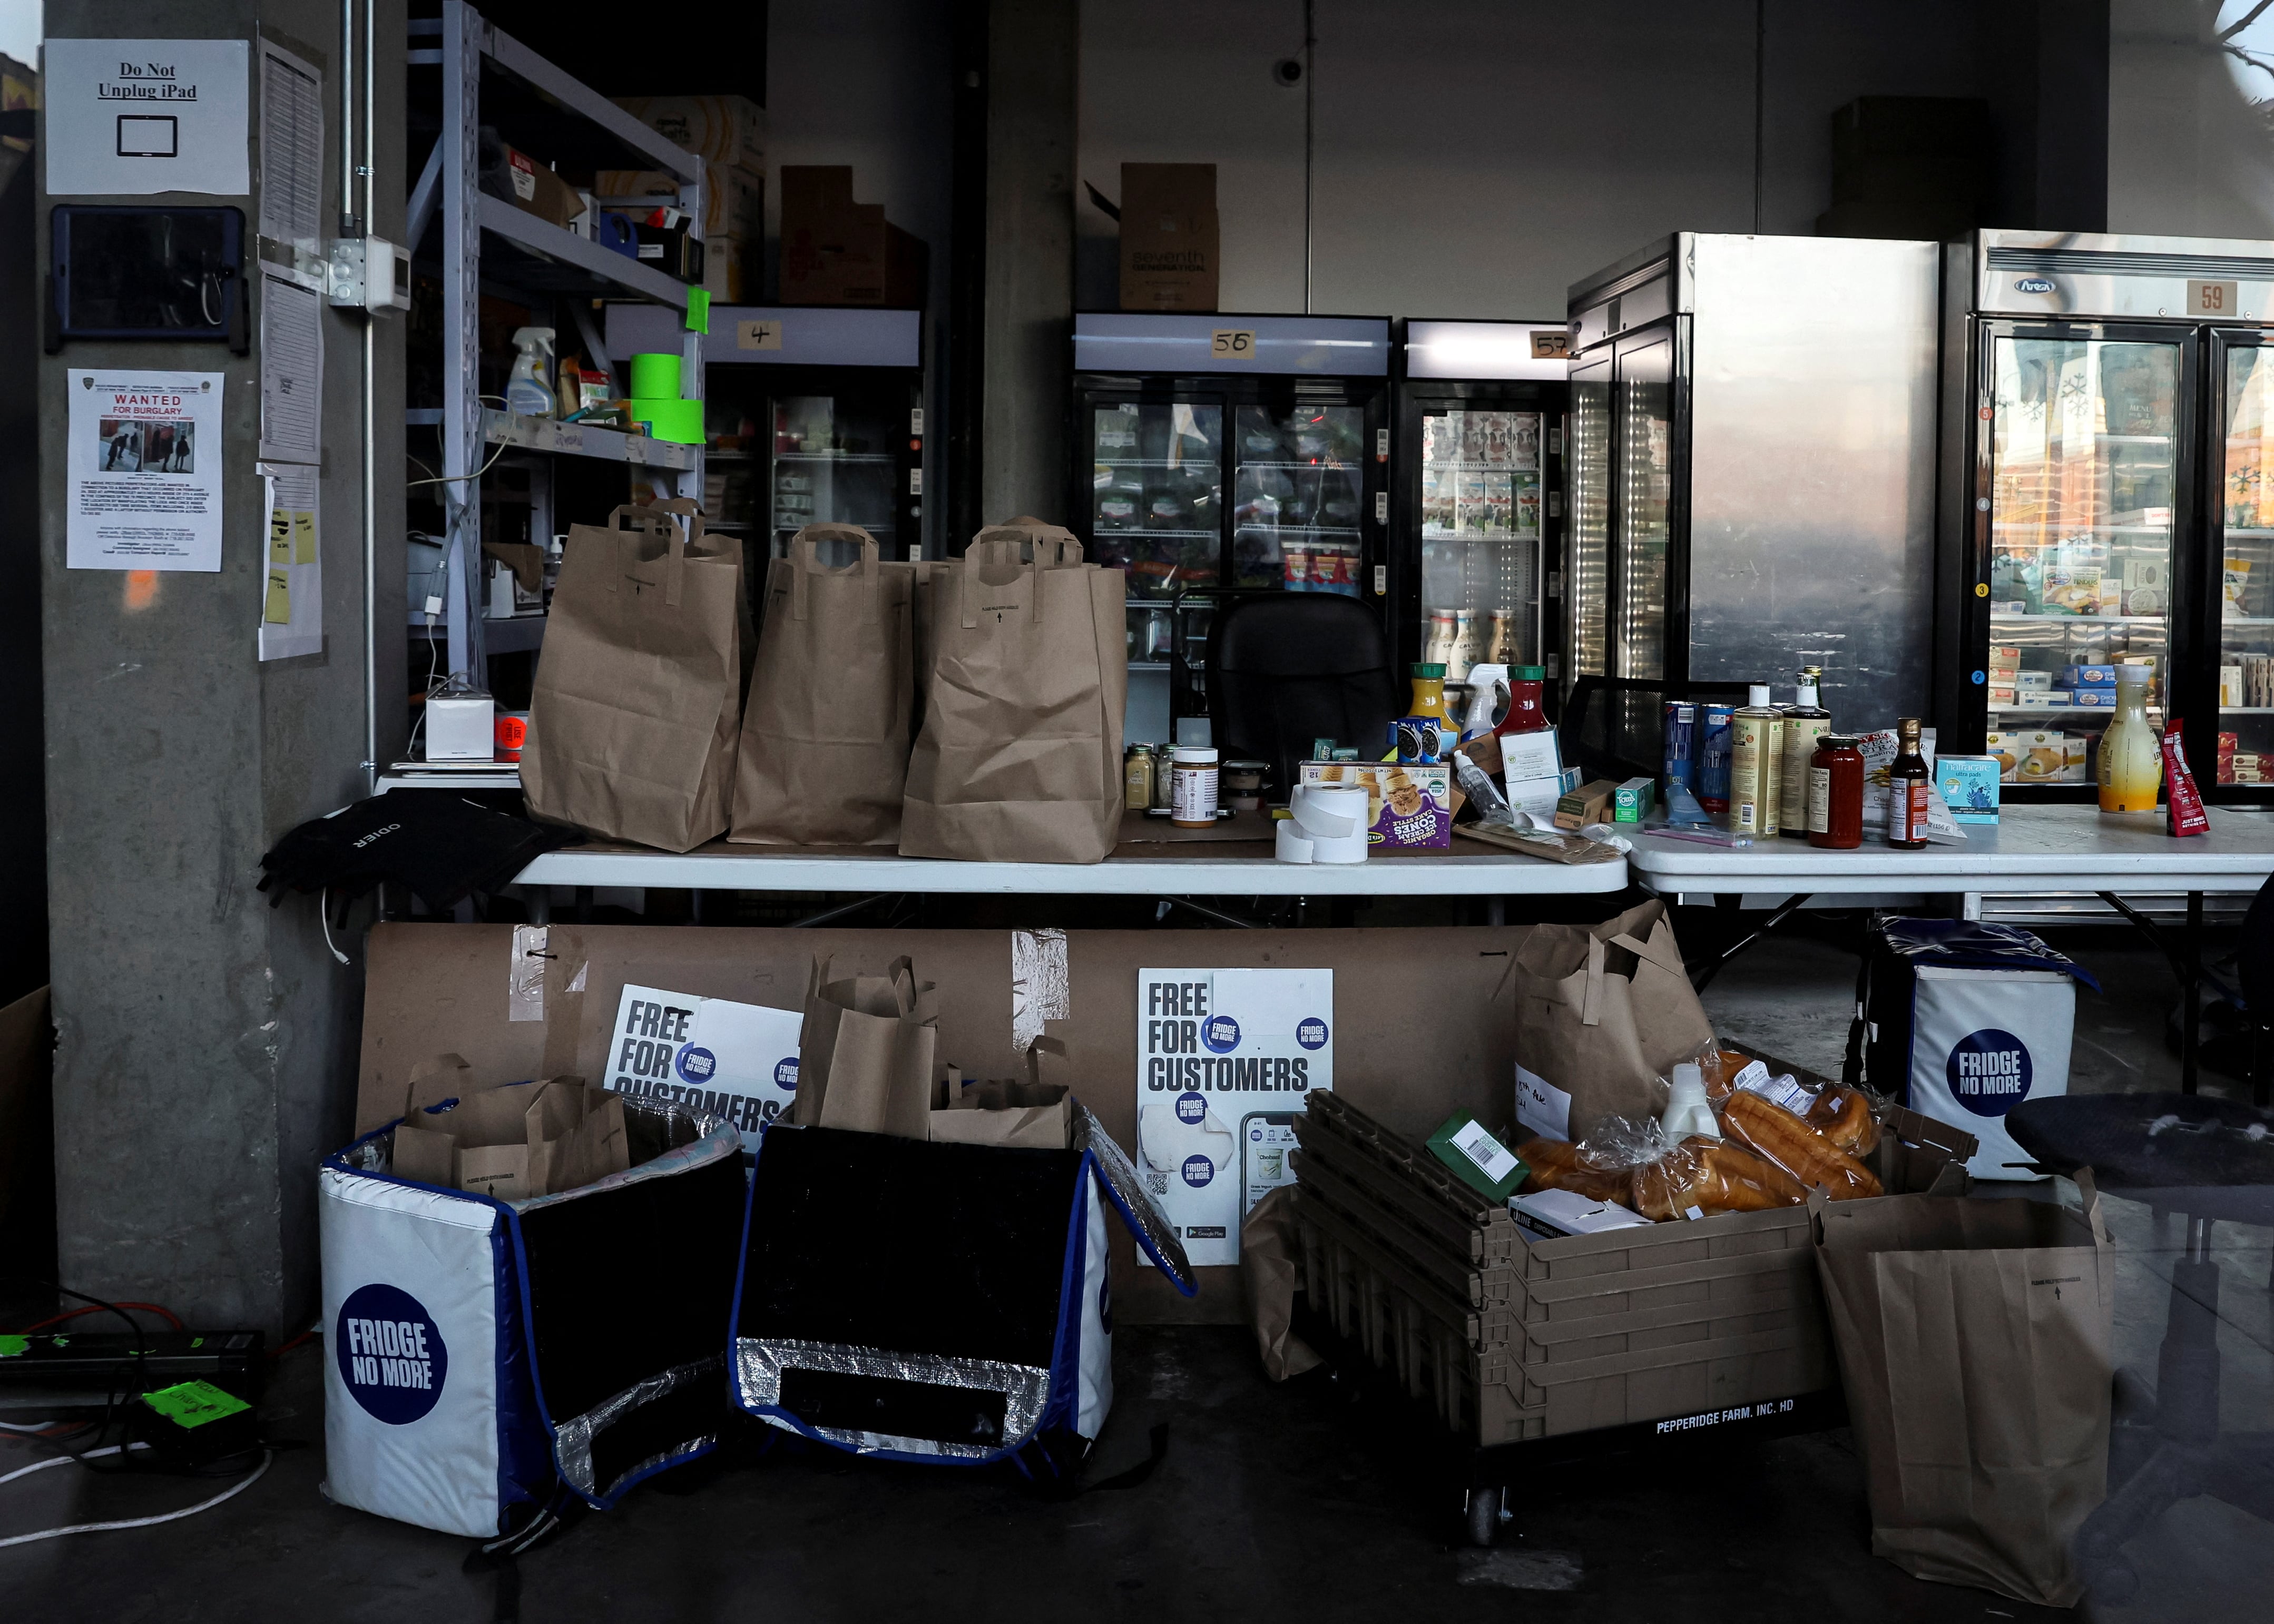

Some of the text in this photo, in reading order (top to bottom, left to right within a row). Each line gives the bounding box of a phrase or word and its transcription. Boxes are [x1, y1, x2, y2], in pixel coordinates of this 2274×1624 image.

[120, 62, 175, 77] Do Not
[99, 83, 197, 99] Unplug iPad
[2202, 286, 2223, 309] 59
[751, 326, 770, 343] 4
[1537, 337, 1568, 356] 57
[115, 395, 181, 406] WANTED
[1983, 410, 1988, 419] 5
[1979, 586, 1985, 595] 3
[1975, 673, 1981, 682] 2
[1946, 763, 1991, 772] natracare
[1617, 794, 1635, 804] Tom's
[1393, 809, 1433, 826] CAKE STYLE
[1394, 814, 1436, 835] CONES
[352, 823, 401, 848] ODIER
[1398, 822, 1438, 840] ICE CREAM
[1403, 829, 1436, 844] ORGANIC
[1149, 983, 1208, 1017] FREE
[626, 1000, 690, 1042] FREE
[1212, 1022, 1237, 1035] FRIDGE
[1149, 1020, 1197, 1054] FOR
[1211, 1032, 1235, 1042] NO MORE
[1300, 1026, 1325, 1036] FRIDGE
[617, 1038, 673, 1079] FOR
[687, 1052, 713, 1068] FRIDGE
[1959, 1050, 2021, 1076] FRIDGE
[685, 1063, 711, 1076] NO MORE
[778, 1073, 786, 1082] NO
[779, 1064, 799, 1076] FRIDG
[1148, 1058, 1308, 1091] CUSTOMERS
[1959, 1075, 2021, 1095] NO MORE
[1179, 1099, 1203, 1109] FRIDGE
[1479, 1137, 1499, 1156] COOKIES
[1185, 1163, 1210, 1173] FRIDGE
[1513, 1210, 1531, 1227] ULINE
[347, 1318, 430, 1359] FRIDGE
[352, 1356, 432, 1389] NO MORE
[1657, 1412, 1719, 1434] PEPPERIDGE
[1757, 1403, 1776, 1416] INC.
[1780, 1399, 1793, 1412] HD
